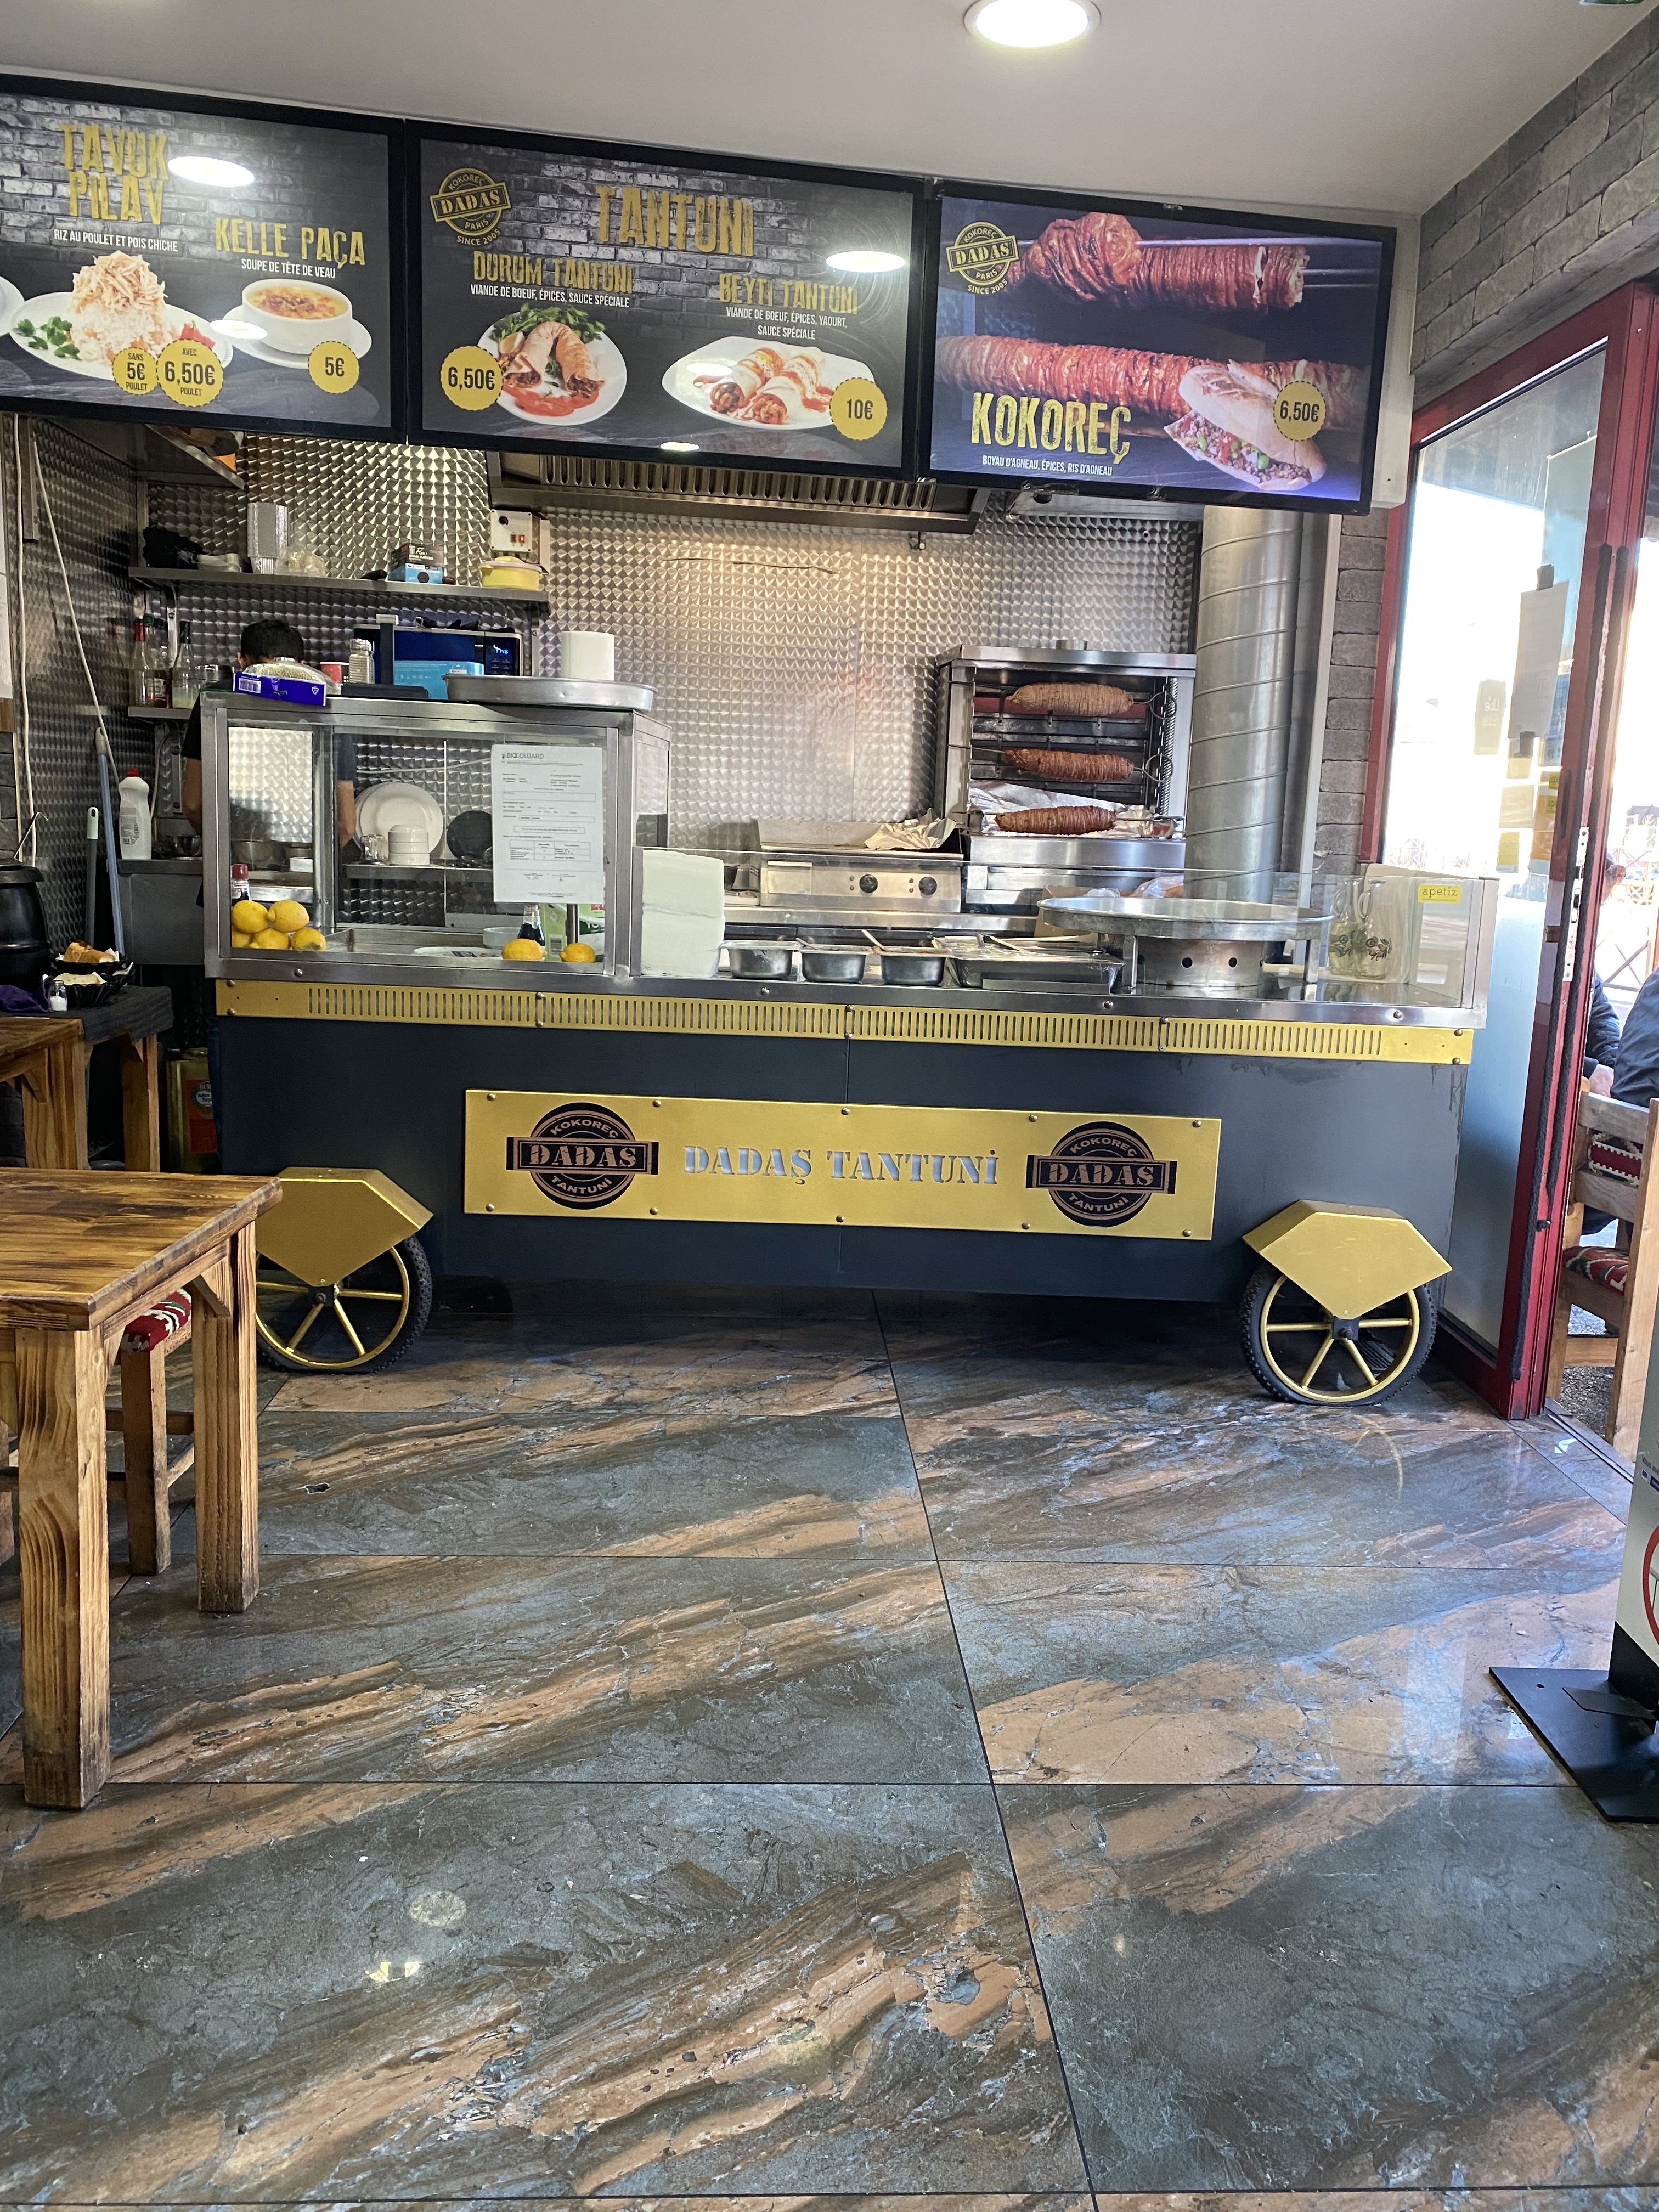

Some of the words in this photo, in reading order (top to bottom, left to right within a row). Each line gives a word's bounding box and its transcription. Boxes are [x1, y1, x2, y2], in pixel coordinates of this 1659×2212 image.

[59, 123, 169, 180] TAVUK
[69, 171, 163, 225] PILAV
[441, 190, 500, 214] DADAS
[465, 218, 489, 230] PARIS
[596, 185, 753, 256] TANTUNI
[54, 229, 68, 240] RIZ
[70, 230, 81, 241] AU
[83, 232, 114, 245] POULET
[116, 235, 126, 246] ET
[128, 236, 146, 249] POIS
[148, 239, 178, 252] CHICHE
[215, 218, 289, 258] KELLE
[301, 227, 365, 269] PAÇA
[456, 235, 481, 245] SINCE
[483, 228, 500, 245] 2005
[955, 242, 1010, 265] DADAS
[241, 258, 267, 270] SOUPE
[269, 262, 279, 272] DE
[281, 261, 301, 274] TÊTE
[302, 265, 313, 275] DE
[314, 266, 336, 279] VEAU
[473, 251, 542, 285] DURUM
[552, 257, 633, 294] TANTUNI
[976, 268, 997, 280] PARIS
[470, 284, 499, 297] VIANDE
[500, 287, 510, 297] DE
[512, 288, 537, 301] BOEUF,
[539, 288, 567, 303] ÉPICES,
[569, 292, 592, 304] SAUCE
[595, 294, 629, 307] SPÉCIALE
[719, 273, 772, 307] BEYTI
[782, 280, 858, 314] TANTUNI
[967, 285, 989, 295] SINCE
[991, 278, 1008, 294] 2005
[726, 307, 753, 318] VIANDE
[754, 309, 764, 319] DE
[765, 310, 789, 324] BOEUF,
[791, 311, 817, 325] ÉPICES,
[819, 315, 847, 328] YAOURT,
[758, 325, 781, 336] SAUCE
[782, 326, 816, 340] SPÉCIALE
[128, 353, 144, 361] SANS
[325, 356, 345, 377] 5€
[127, 362, 145, 380] 5€
[165, 361, 215, 386] 6,50€
[448, 366, 495, 390] 6,50€
[126, 382, 148, 391] POULET
[180, 387, 202, 396] POULET
[847, 399, 873, 420] 10€
[1280, 400, 1319, 422] 6,50€
[971, 392, 1131, 464] KOKOREÇ
[983, 455, 1004, 466] BOYAU
[1006, 457, 1040, 470] D'AGNEAU,
[1041, 459, 1066, 473] ÉPICES,
[1068, 462, 1079, 473] RIS
[1080, 464, 1112, 476] D'AGNEAU
[1423, 886, 1458, 898] apetiz
[550, 1119, 618, 1138] KOKOREÇ
[529, 1144, 636, 1167] DADAS
[1070, 1137, 1137, 1157] KOKOREÇ
[684, 1146, 812, 1185] DADAŞ
[826, 1149, 999, 1184] TANTUNİ
[1048, 1163, 1154, 1186] DADAS
